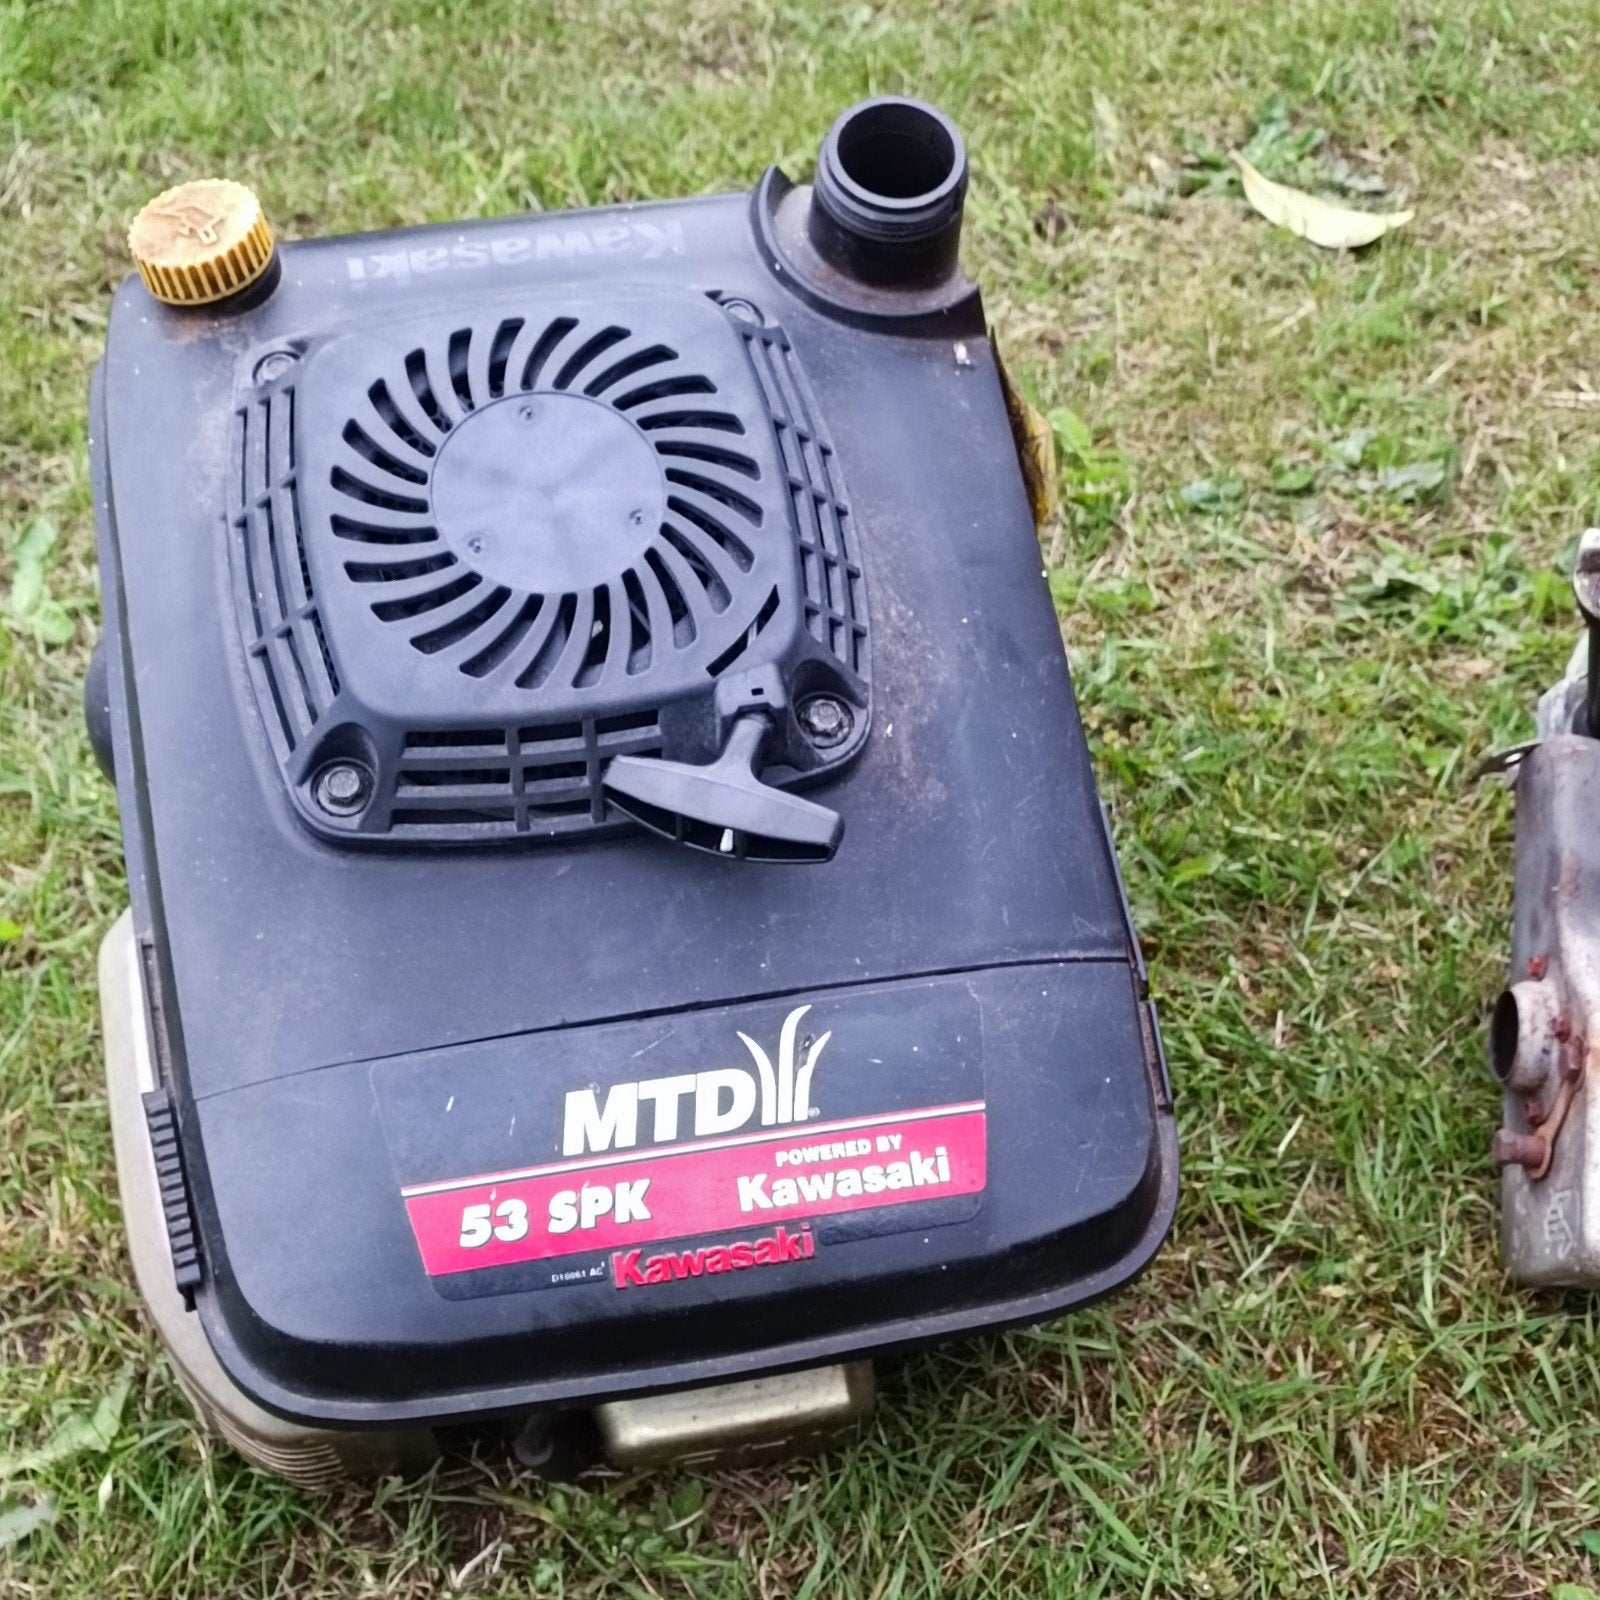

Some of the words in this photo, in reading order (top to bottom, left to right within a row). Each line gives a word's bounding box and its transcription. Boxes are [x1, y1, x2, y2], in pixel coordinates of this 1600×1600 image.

[346, 219, 686, 290] Kawasaki
[563, 1068, 756, 1156] MTD
[737, 1146, 951, 1212] Kawasaki
[775, 1139, 872, 1167] POWERED
[876, 1133, 902, 1152] BY
[459, 1198, 528, 1248] 53
[548, 1179, 651, 1233] SPK
[611, 1222, 815, 1289] Kawasaki
